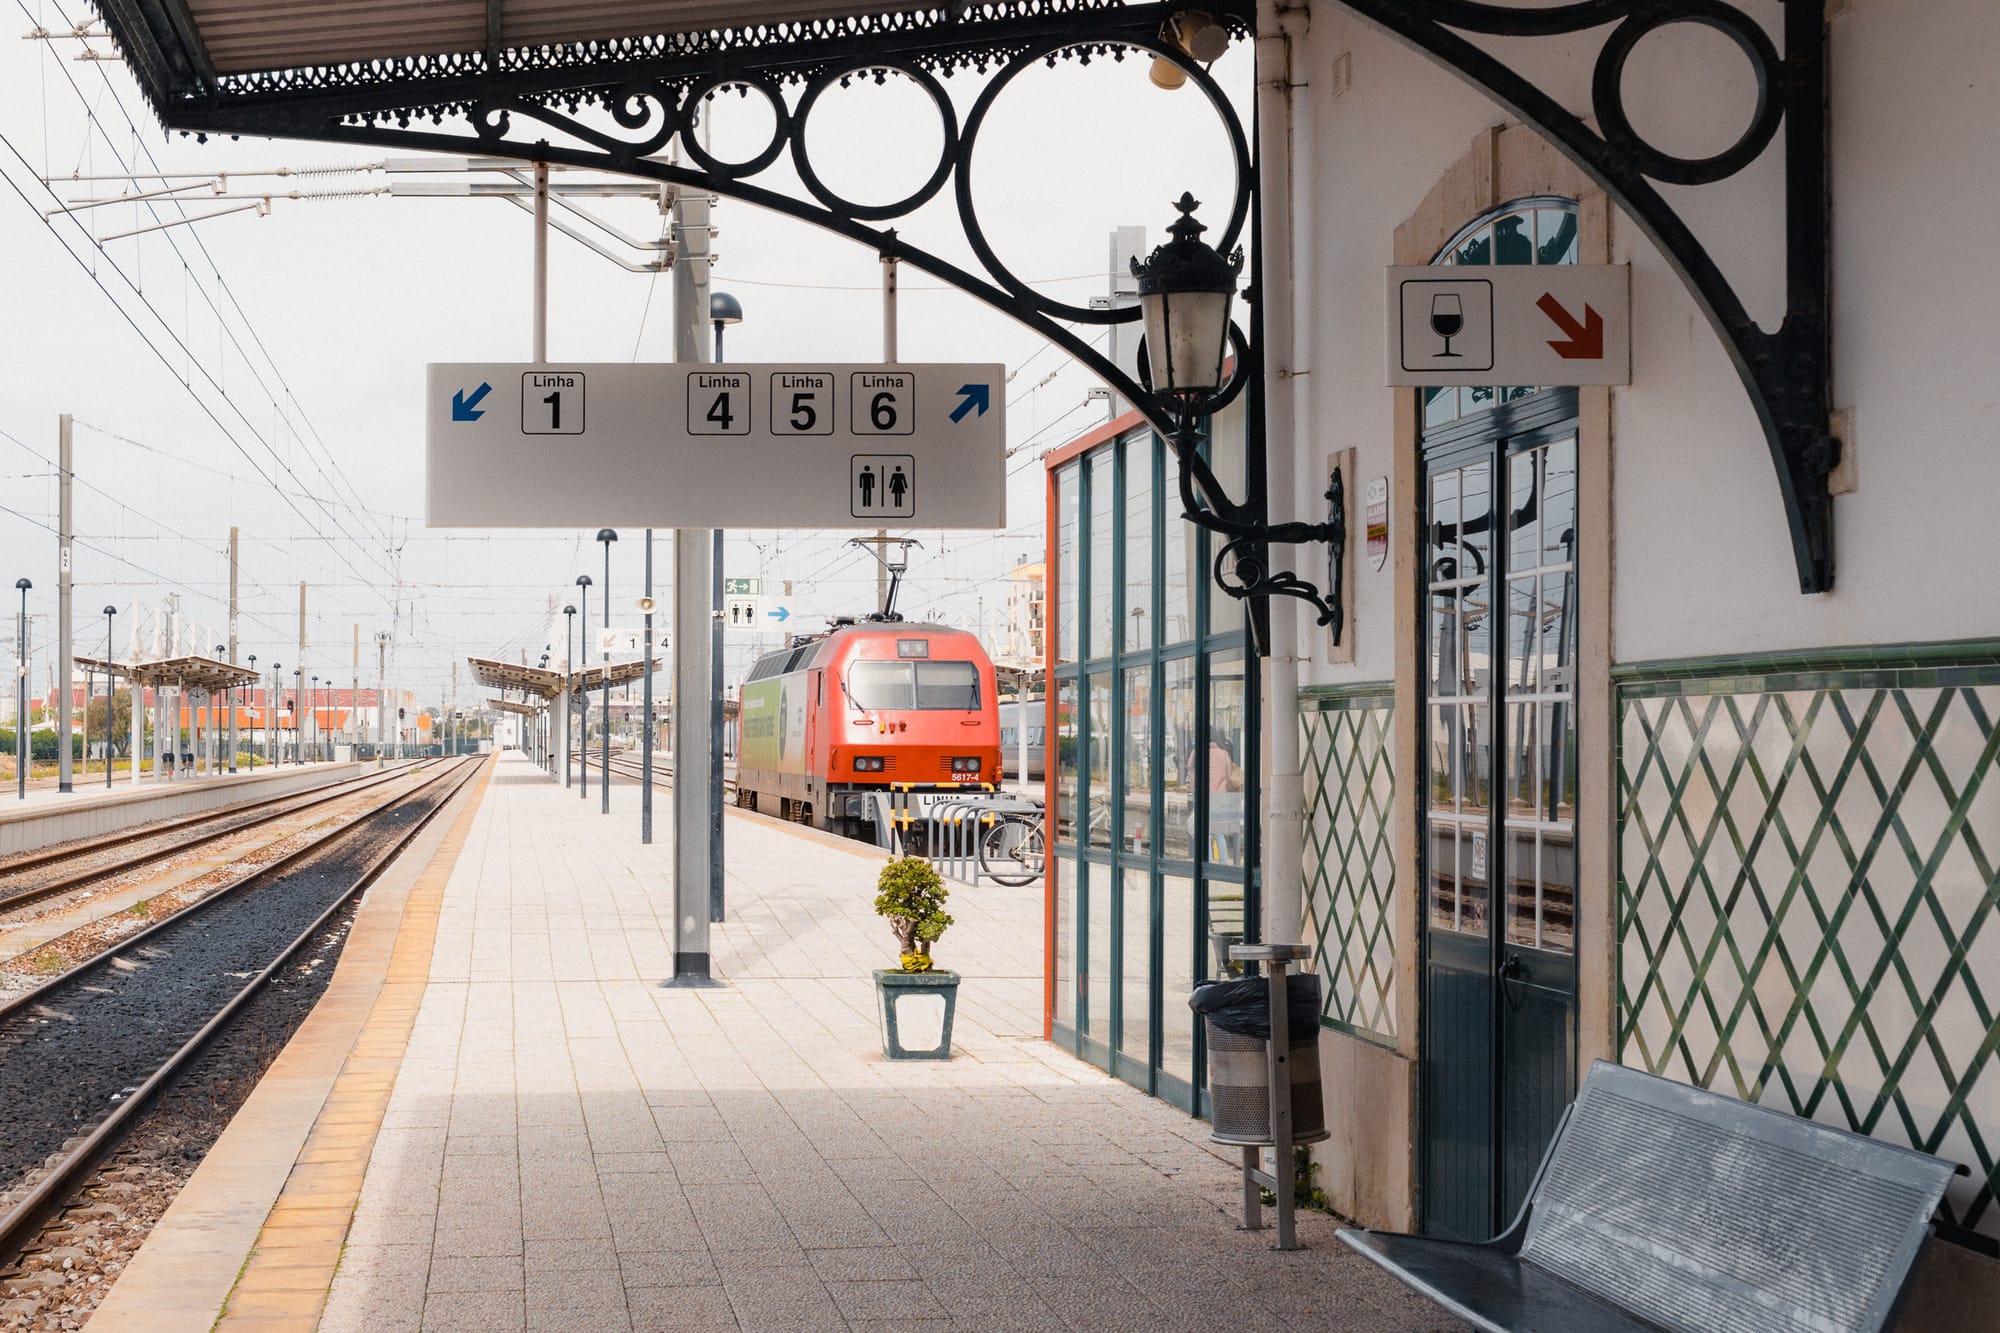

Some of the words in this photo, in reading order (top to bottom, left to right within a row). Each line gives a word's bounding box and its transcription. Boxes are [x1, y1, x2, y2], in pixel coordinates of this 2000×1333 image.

[533, 375, 574, 388] Linha
[699, 375, 741, 388] Linha
[782, 375, 824, 388] Linha
[862, 375, 904, 388] Linha
[543, 392, 561, 430] 1
[706, 392, 734, 430] 4
[789, 392, 817, 431] 5
[870, 392, 898, 430] 6
[629, 638, 635, 648] 1
[661, 638, 669, 648] 4
